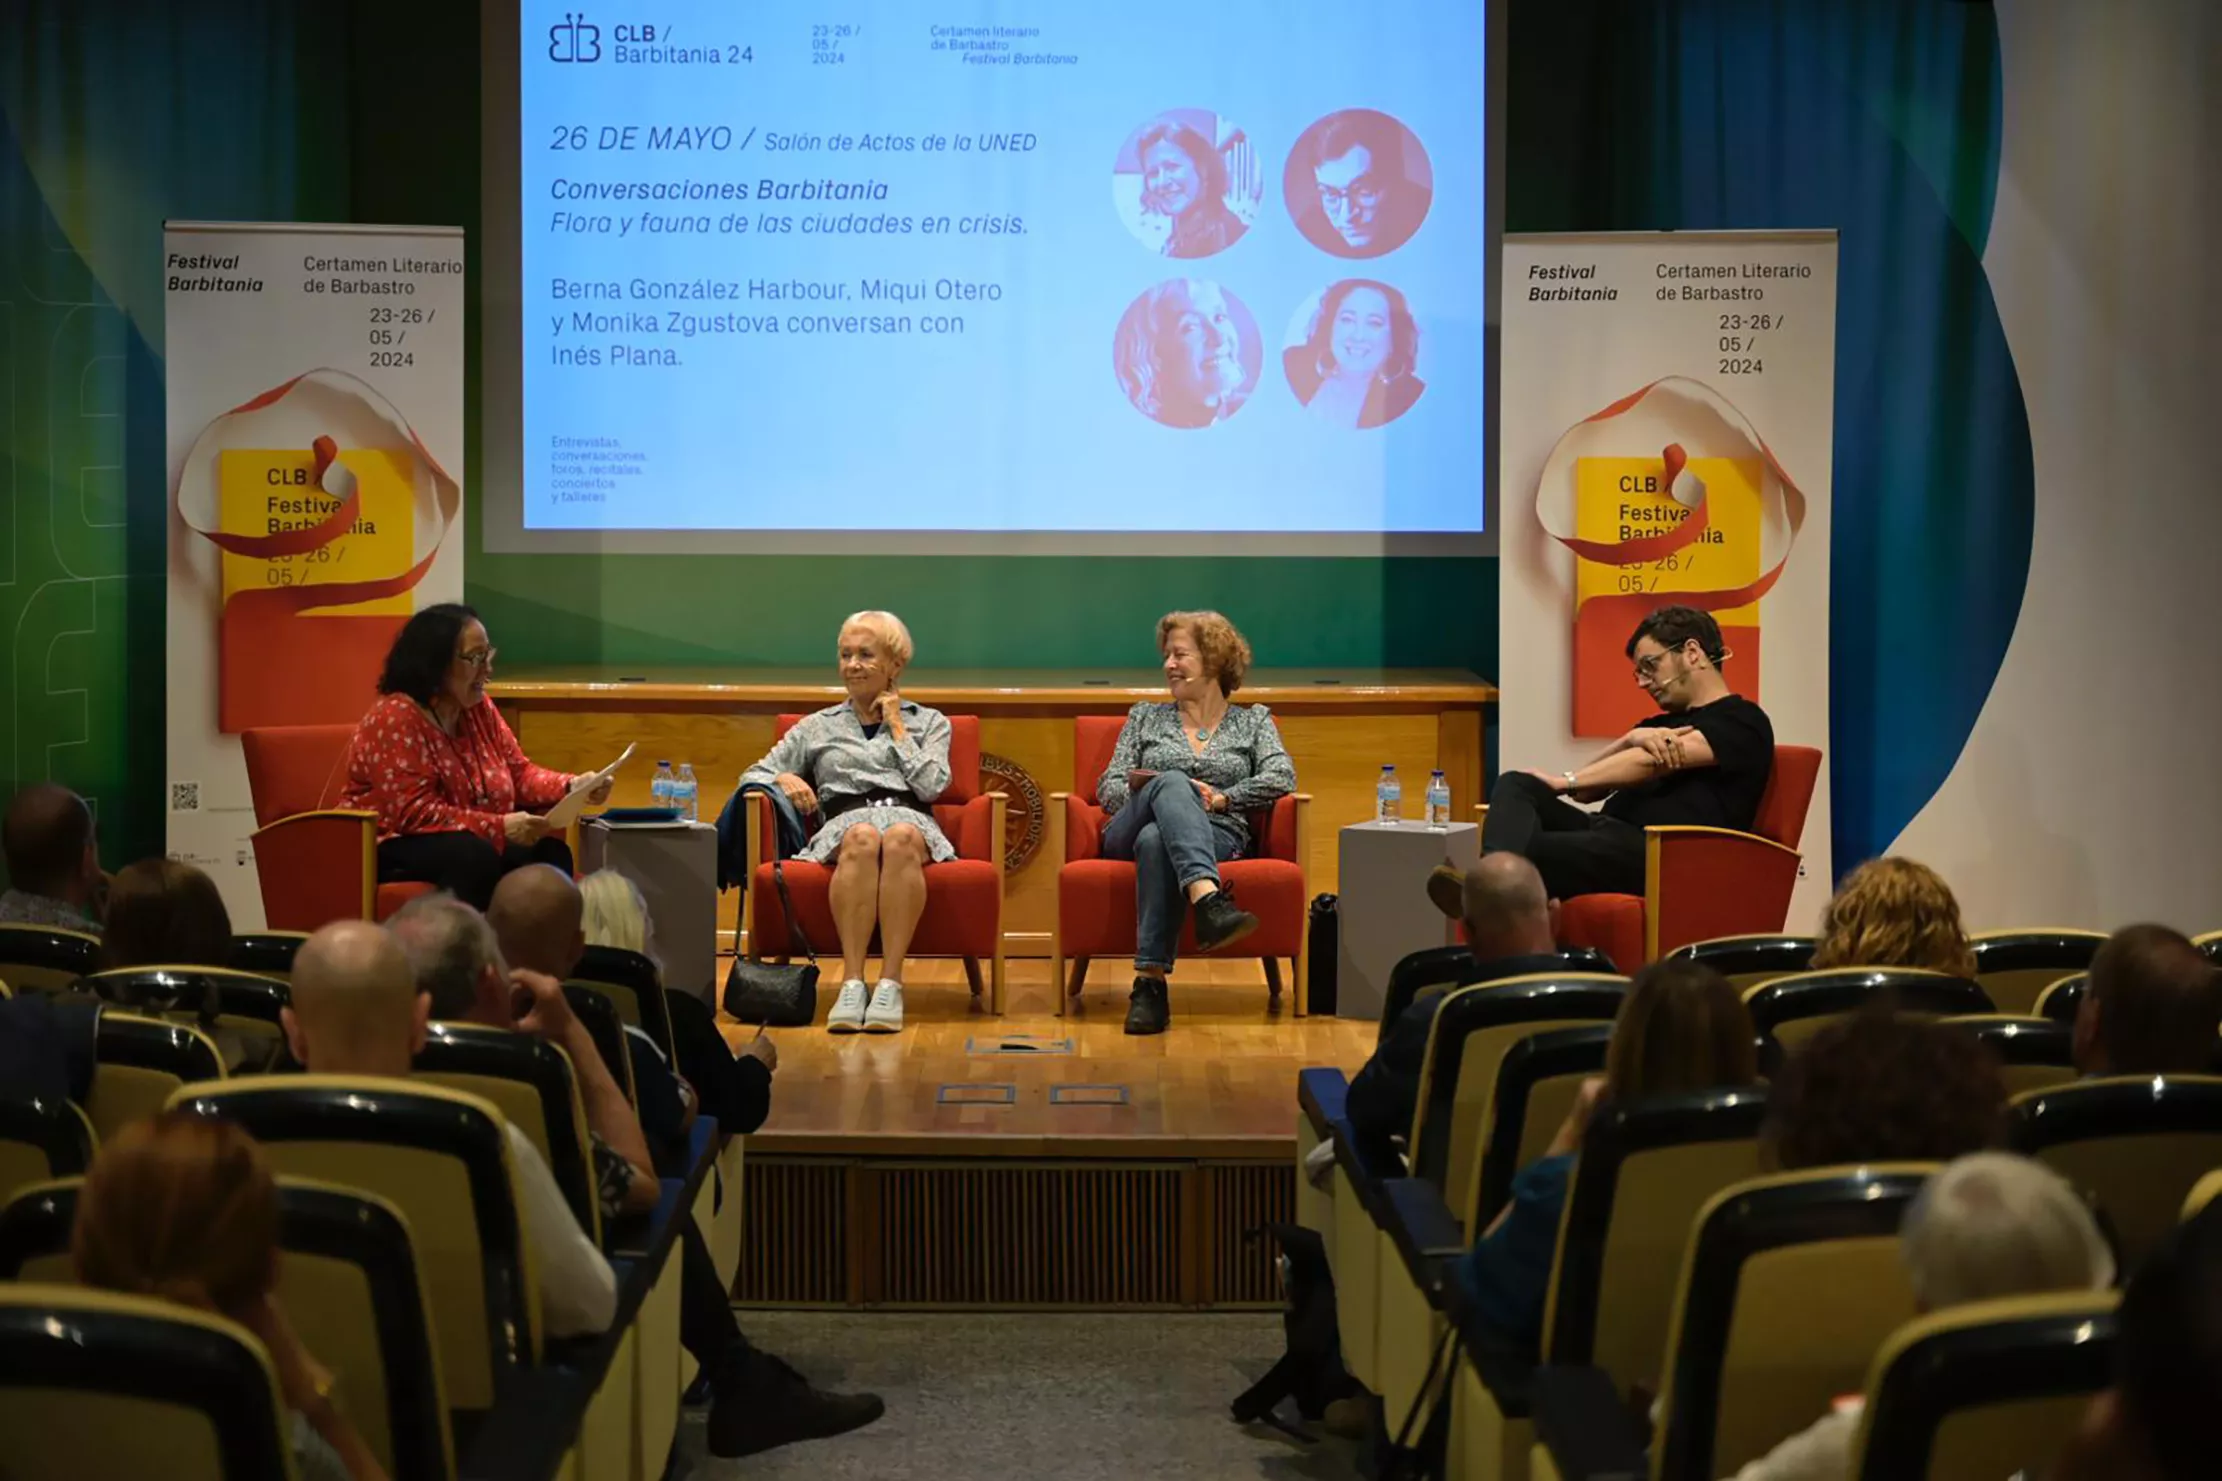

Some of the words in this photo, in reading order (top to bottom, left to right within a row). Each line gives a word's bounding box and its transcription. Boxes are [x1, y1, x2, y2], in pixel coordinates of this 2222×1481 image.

[614, 25, 655, 42] CLB
[812, 25, 851, 37] 23-26
[930, 25, 990, 37] Certamen
[812, 38, 829, 50] 05
[930, 39, 947, 50] de
[949, 38, 1009, 51] Barbastro
[614, 44, 721, 64] Barbitania
[727, 45, 754, 64] 24
[812, 52, 845, 65] 2024
[962, 53, 1010, 65] Festival
[1013, 52, 1079, 65] Barbitania
[550, 125, 588, 151] 26
[598, 126, 639, 151] DE
[647, 126, 732, 151] MAYO
[764, 132, 822, 152] Salón
[827, 133, 854, 152] de
[857, 133, 916, 152] Actos
[921, 133, 947, 152] de
[953, 133, 973, 152] la
[978, 133, 1038, 152] UNED
[551, 179, 749, 201] Conversaciones
[757, 178, 889, 201] Barbitania
[551, 212, 613, 234] Flora
[619, 217, 633, 238] y
[641, 212, 710, 234] fauna
[719, 212, 749, 234] de
[757, 212, 793, 234] las
[801, 212, 914, 235] ciudades
[921, 216, 951, 235] en
[958, 213, 1028, 235] crisis.
[167, 254, 240, 271] Festival
[304, 255, 388, 273] Certamen
[393, 257, 463, 274] Literario
[1656, 263, 1738, 279] Certamen
[1742, 263, 1812, 279] Literario
[1528, 264, 1597, 280] Festival
[167, 276, 264, 293] Barbitania
[304, 278, 326, 294] de
[331, 278, 415, 295] Barbastro
[551, 278, 622, 301] Berna
[630, 278, 740, 301] González
[748, 279, 852, 305] Harbour,
[860, 279, 927, 306] Miqui
[935, 279, 1003, 302] Otero
[1656, 285, 1678, 301] de
[1682, 285, 1764, 301] Barbastro
[1528, 286, 1619, 302] Barbitania
[370, 308, 423, 324] 23-26
[551, 316, 564, 338] y
[573, 311, 660, 334] Monika
[667, 312, 780, 338] Zgustova
[787, 316, 912, 335] conversan
[920, 316, 964, 334] con
[1719, 314, 1771, 330] 23-26
[369, 329, 393, 346] 05
[1719, 336, 1742, 352] 05
[369, 352, 414, 368] 2024
[552, 345, 602, 367] Inés
[611, 345, 683, 367] Plana.
[1719, 358, 1763, 375] 2024
[267, 468, 307, 486] CLB
[1619, 475, 1657, 493] CLB
[267, 497, 342, 514] Festiva
[1619, 504, 1691, 521] Festiva
[267, 568, 293, 586] 05
[1618, 574, 1643, 592] 05
